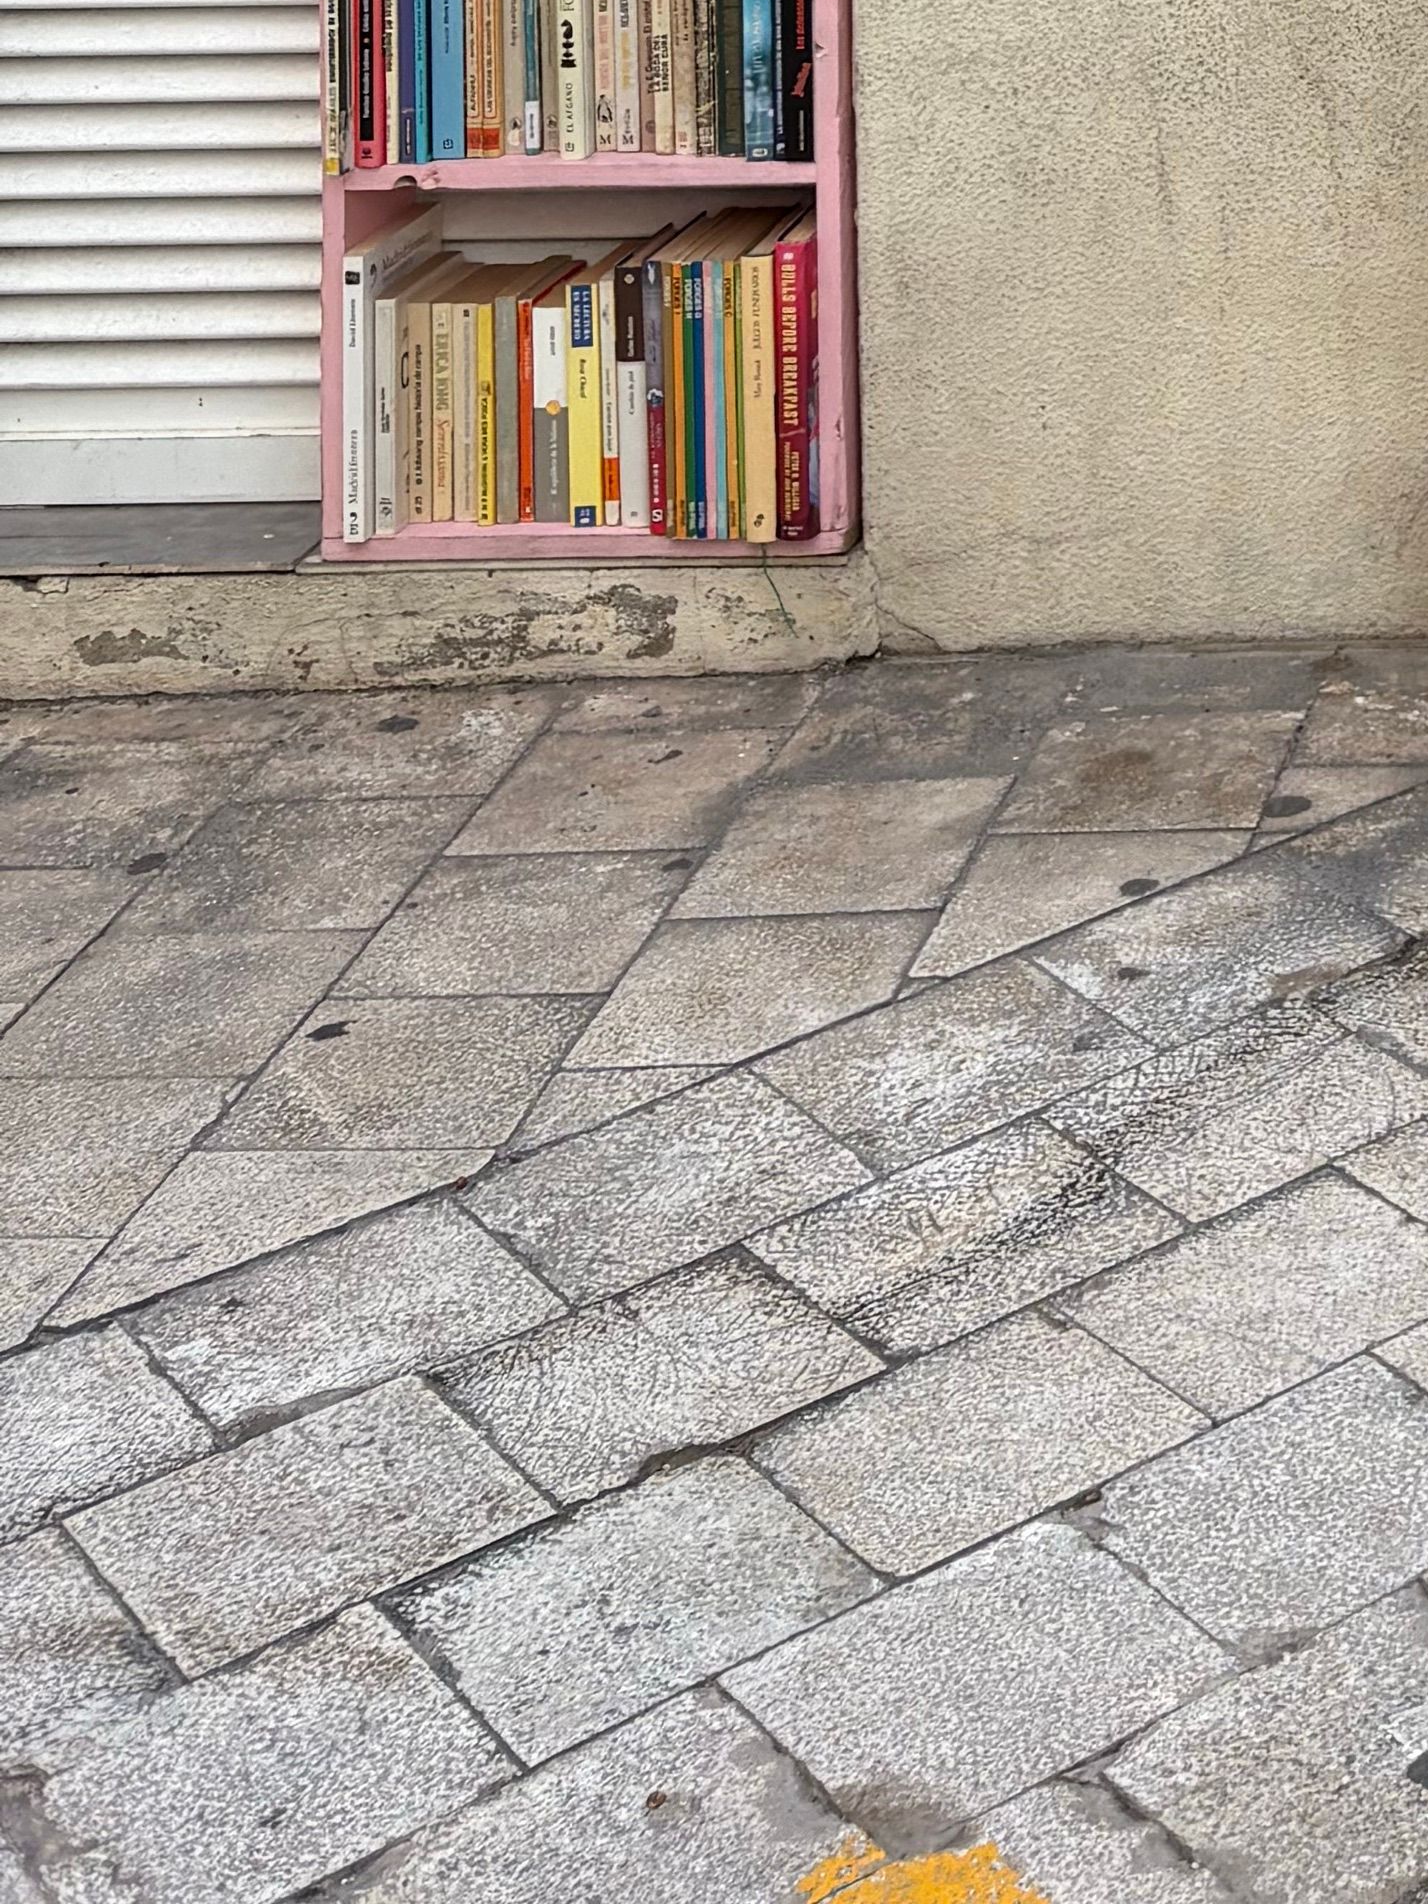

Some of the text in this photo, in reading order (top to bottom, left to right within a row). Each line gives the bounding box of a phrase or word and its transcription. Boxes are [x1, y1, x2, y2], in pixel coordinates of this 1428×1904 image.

[780, 263, 800, 426] BULLS BEFORE BREAKFAST
